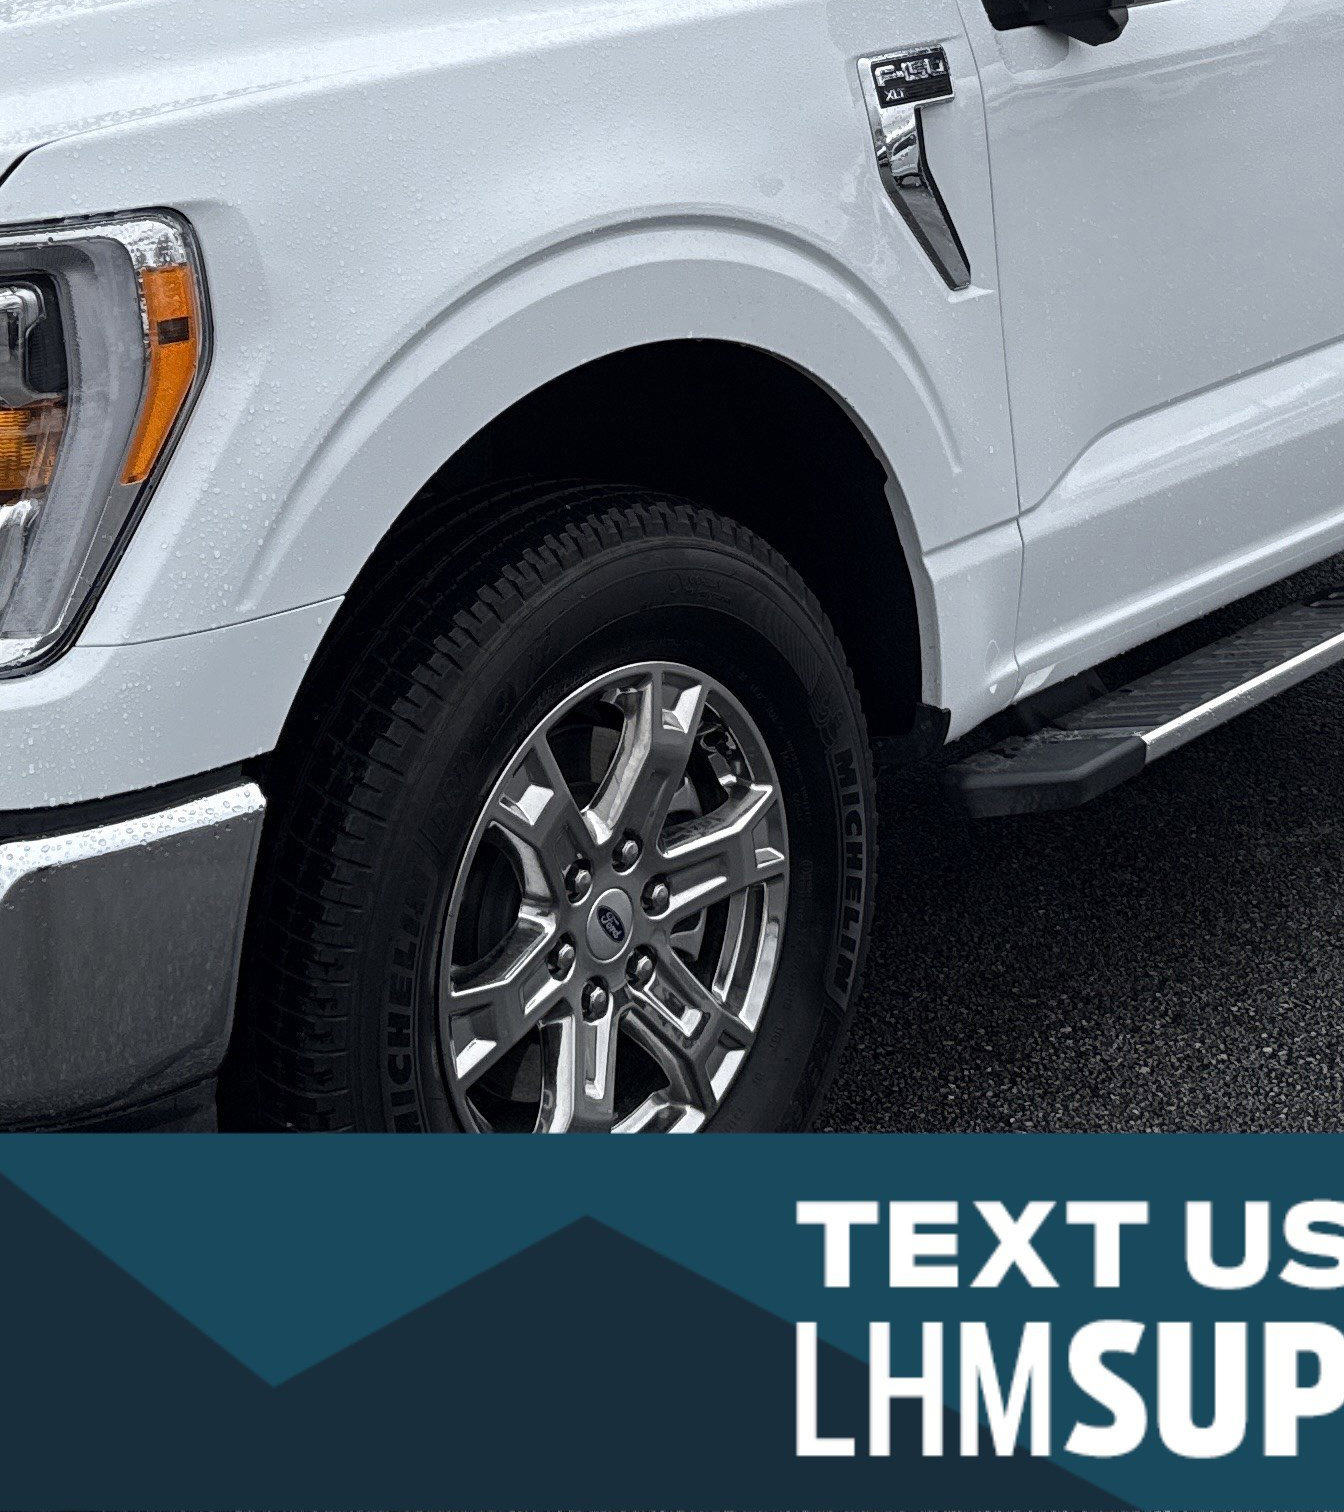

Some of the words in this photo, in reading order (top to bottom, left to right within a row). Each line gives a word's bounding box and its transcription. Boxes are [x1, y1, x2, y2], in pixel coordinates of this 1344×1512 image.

[885, 88, 905, 101] XLT
[833, 748, 864, 995] MICHELIN
[601, 911, 622, 939] Ford
